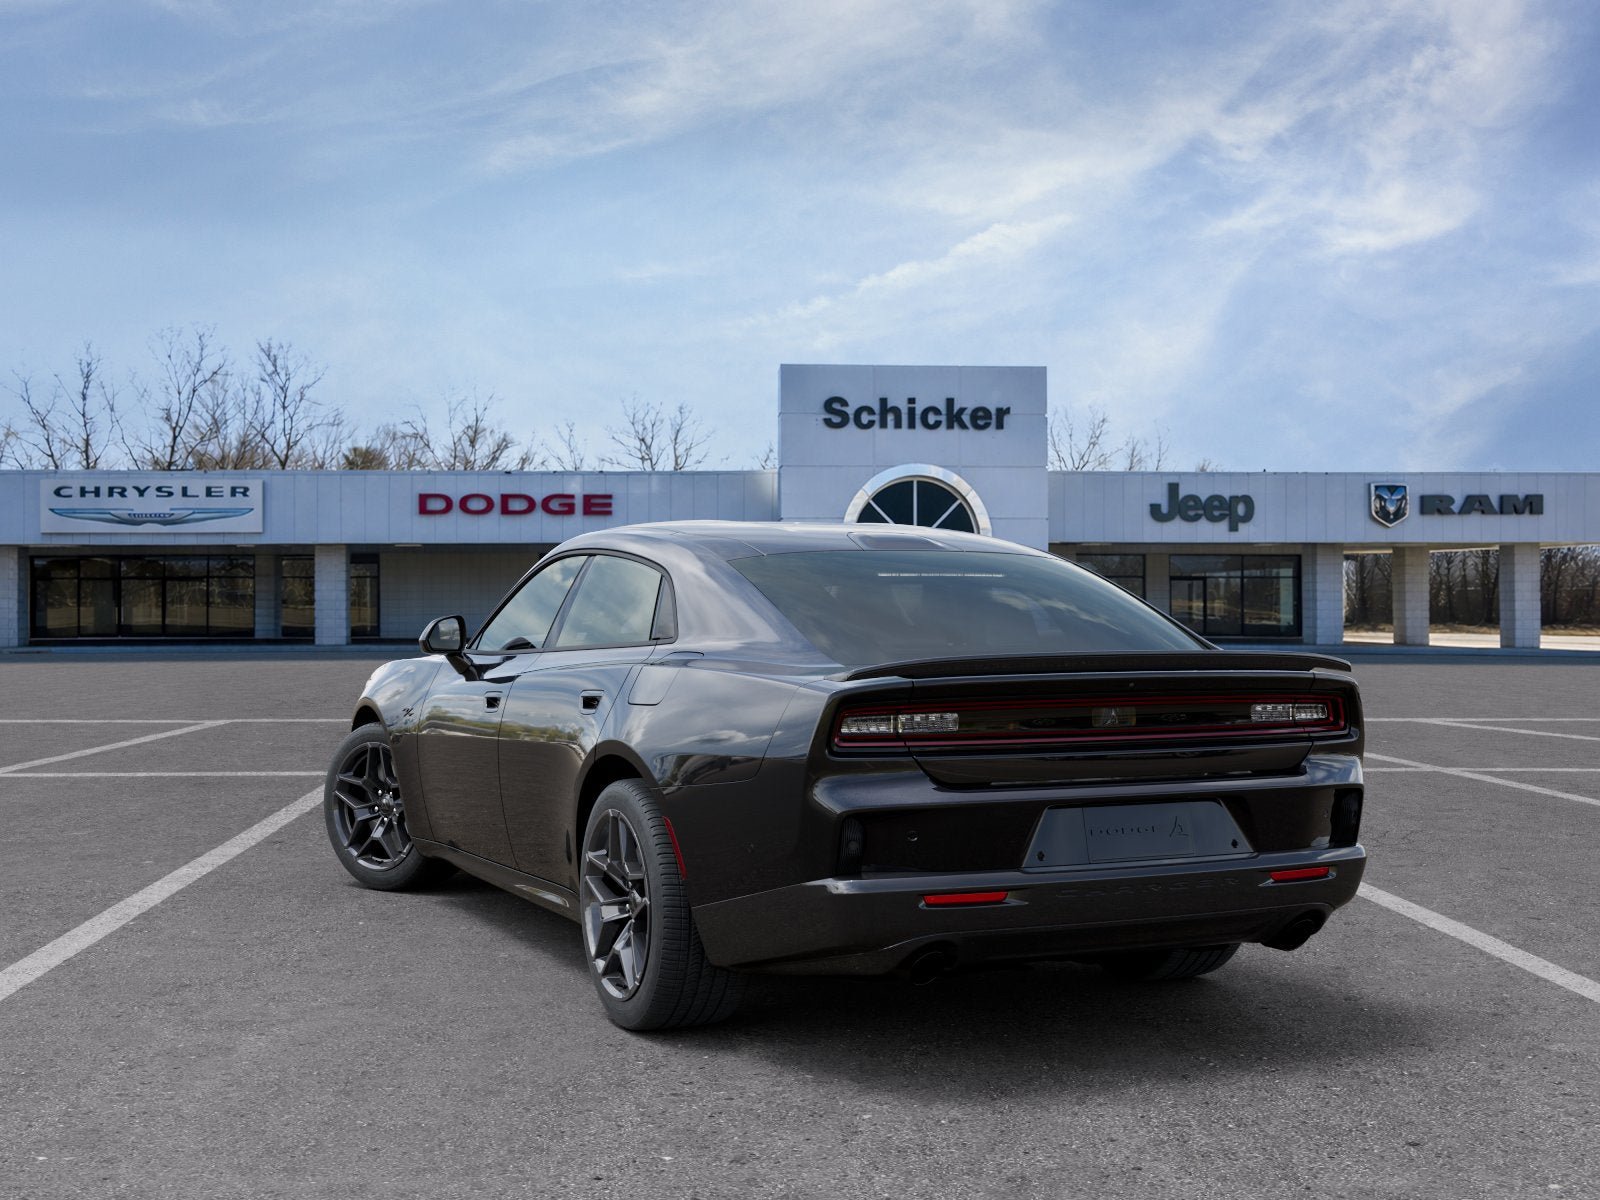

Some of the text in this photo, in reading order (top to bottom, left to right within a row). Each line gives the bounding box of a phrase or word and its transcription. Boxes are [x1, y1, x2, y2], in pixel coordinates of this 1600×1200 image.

[822, 396, 1011, 430] Schicker
[53, 485, 251, 499] CHRYSLER
[418, 493, 613, 516] DODGE
[1149, 482, 1255, 532] Jeep
[1419, 494, 1545, 516] RAM
